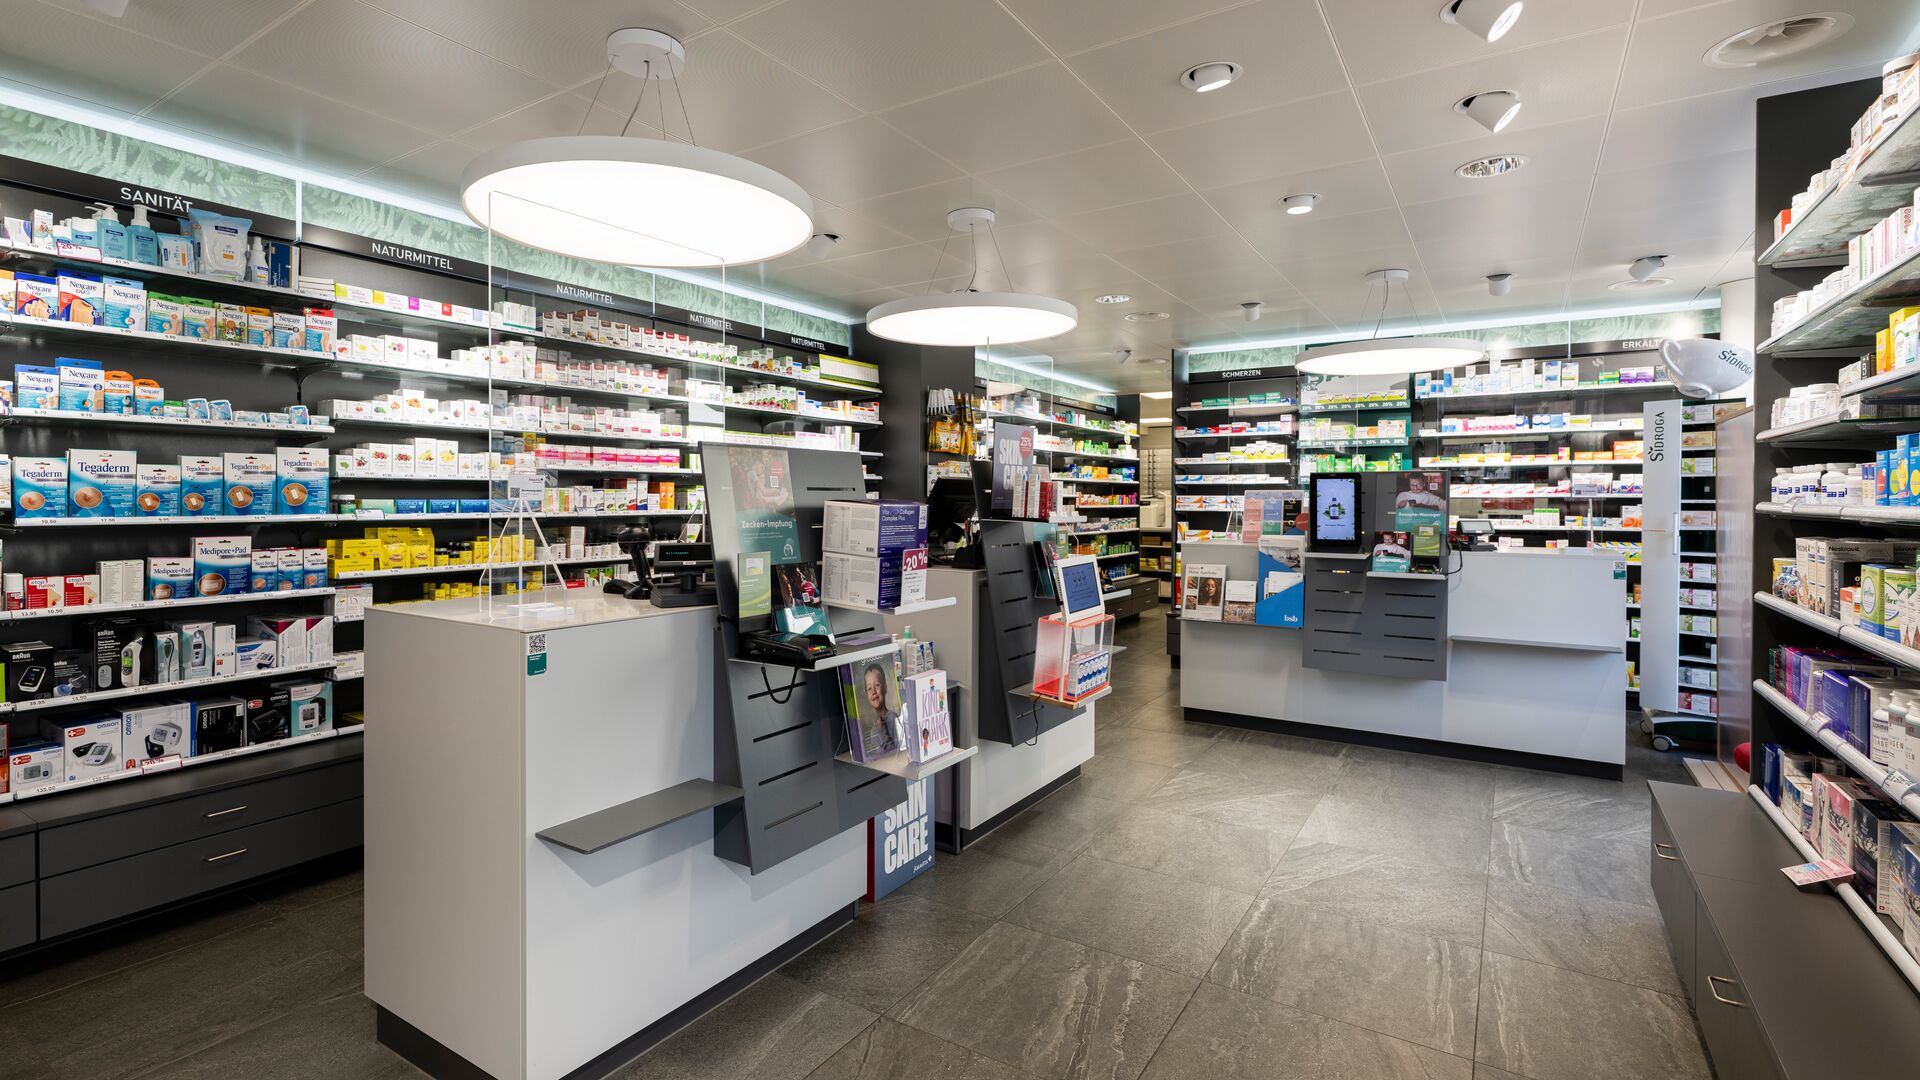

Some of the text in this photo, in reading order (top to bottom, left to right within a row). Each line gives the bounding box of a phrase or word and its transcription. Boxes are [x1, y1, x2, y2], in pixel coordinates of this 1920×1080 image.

[120, 187, 193, 213] SANITÄT
[372, 242, 453, 270] NATURMITTEL
[26, 283, 53, 294] Nexcare
[69, 280, 97, 292] Nexcare
[113, 289, 141, 300] Nexcare
[556, 284, 615, 305] NATURMITTEL
[157, 301, 179, 312] Nexcare
[190, 306, 211, 316] Nexcare
[222, 311, 244, 321] Nexcare
[311, 318, 333, 326] Nexcare
[690, 313, 733, 331] NATURMITTEL
[791, 336, 826, 351] NATURMITTEL
[1622, 338, 1661, 349] ERKÄLT
[69, 370, 98, 380] Nexcare
[1222, 369, 1261, 378] SCHMERZEN
[26, 375, 53, 384] Nexcare
[1020, 437, 1033, 447] 25%
[1649, 411, 1665, 462] SIDROGA
[1000, 438, 1022, 465] SKIN
[78, 462, 130, 474] Tegaderm
[20, 469, 63, 480] Tegaderm
[741, 520, 793, 530] Zecken-Impfung
[903, 550, 928, 571] -20 %
[1284, 614, 1298, 622] bsb
[97, 721, 119, 729] OMRON
[884, 778, 926, 833] SKIN
[884, 815, 928, 874] CARE
